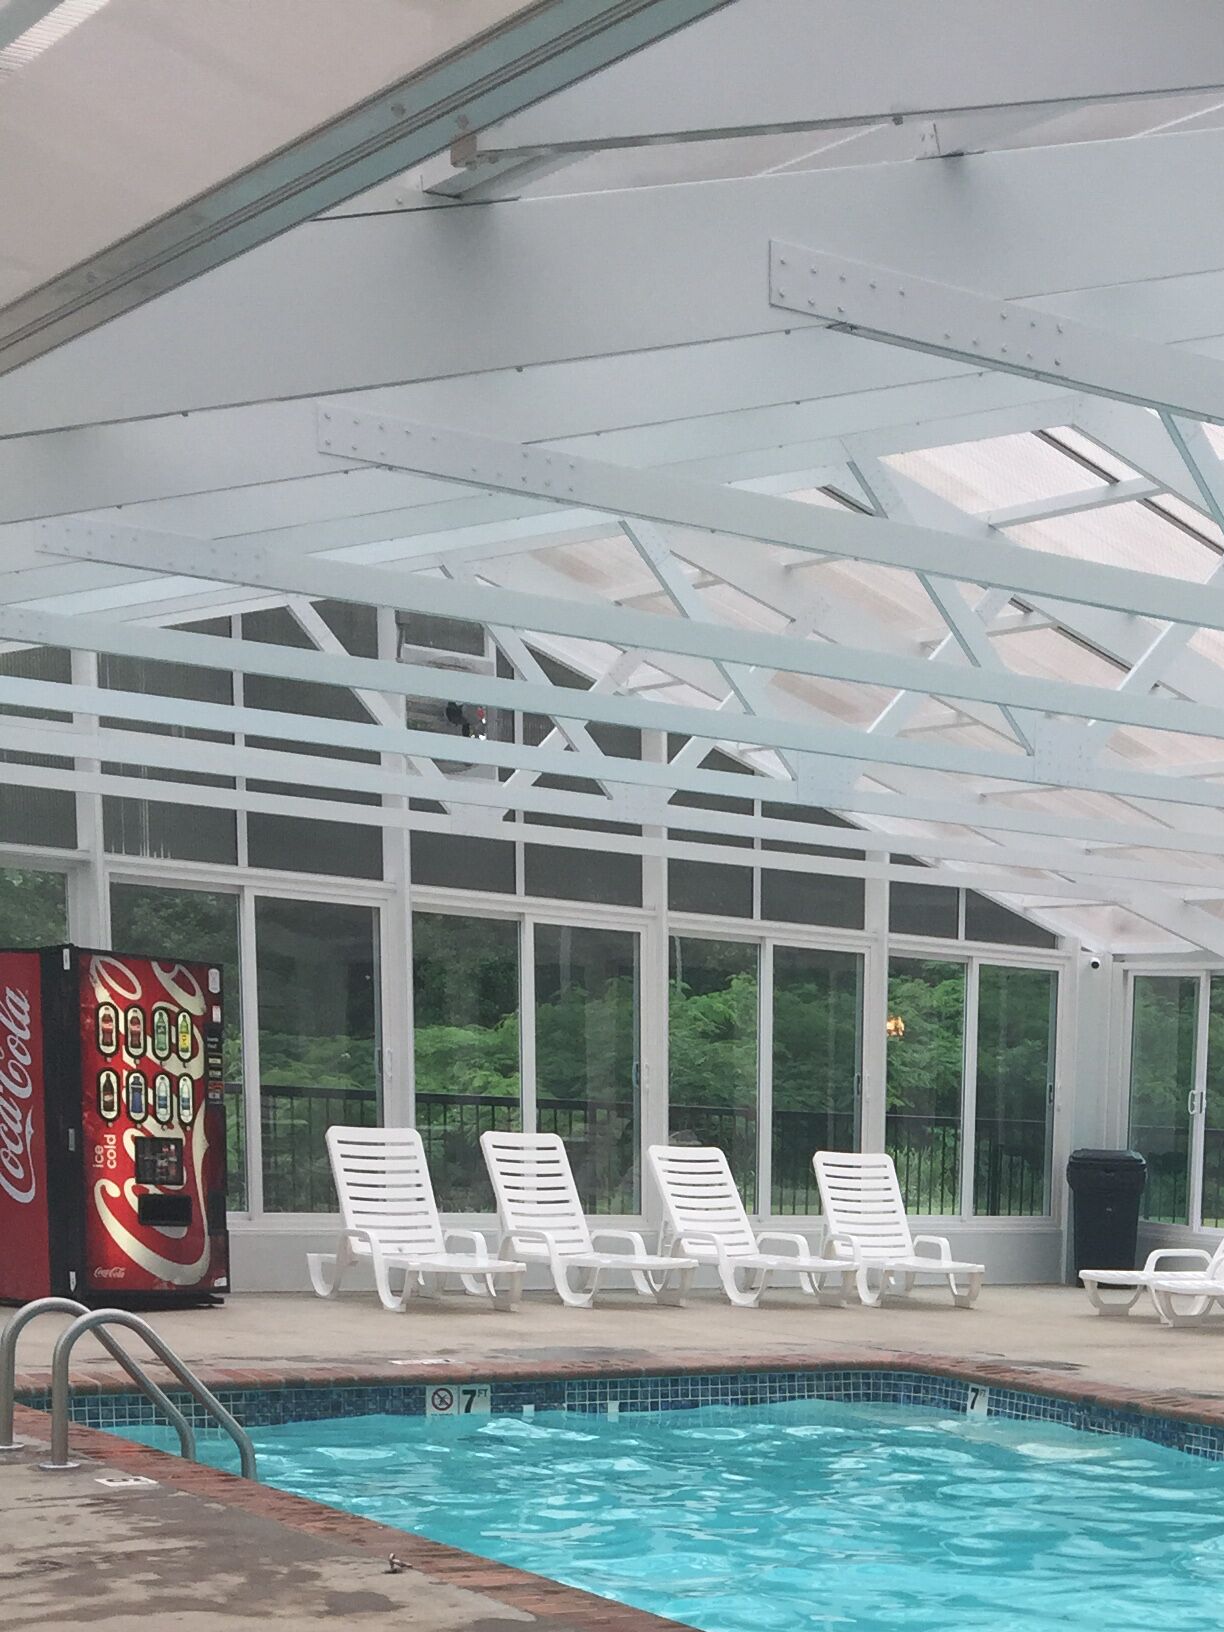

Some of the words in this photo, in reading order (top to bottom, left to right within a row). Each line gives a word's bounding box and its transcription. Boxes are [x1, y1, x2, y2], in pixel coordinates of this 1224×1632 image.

[93, 1145, 104, 1168] ice
[104, 1134, 117, 1169] cold
[461, 1389, 477, 1414] 7
[970, 1387, 979, 1410] 7
